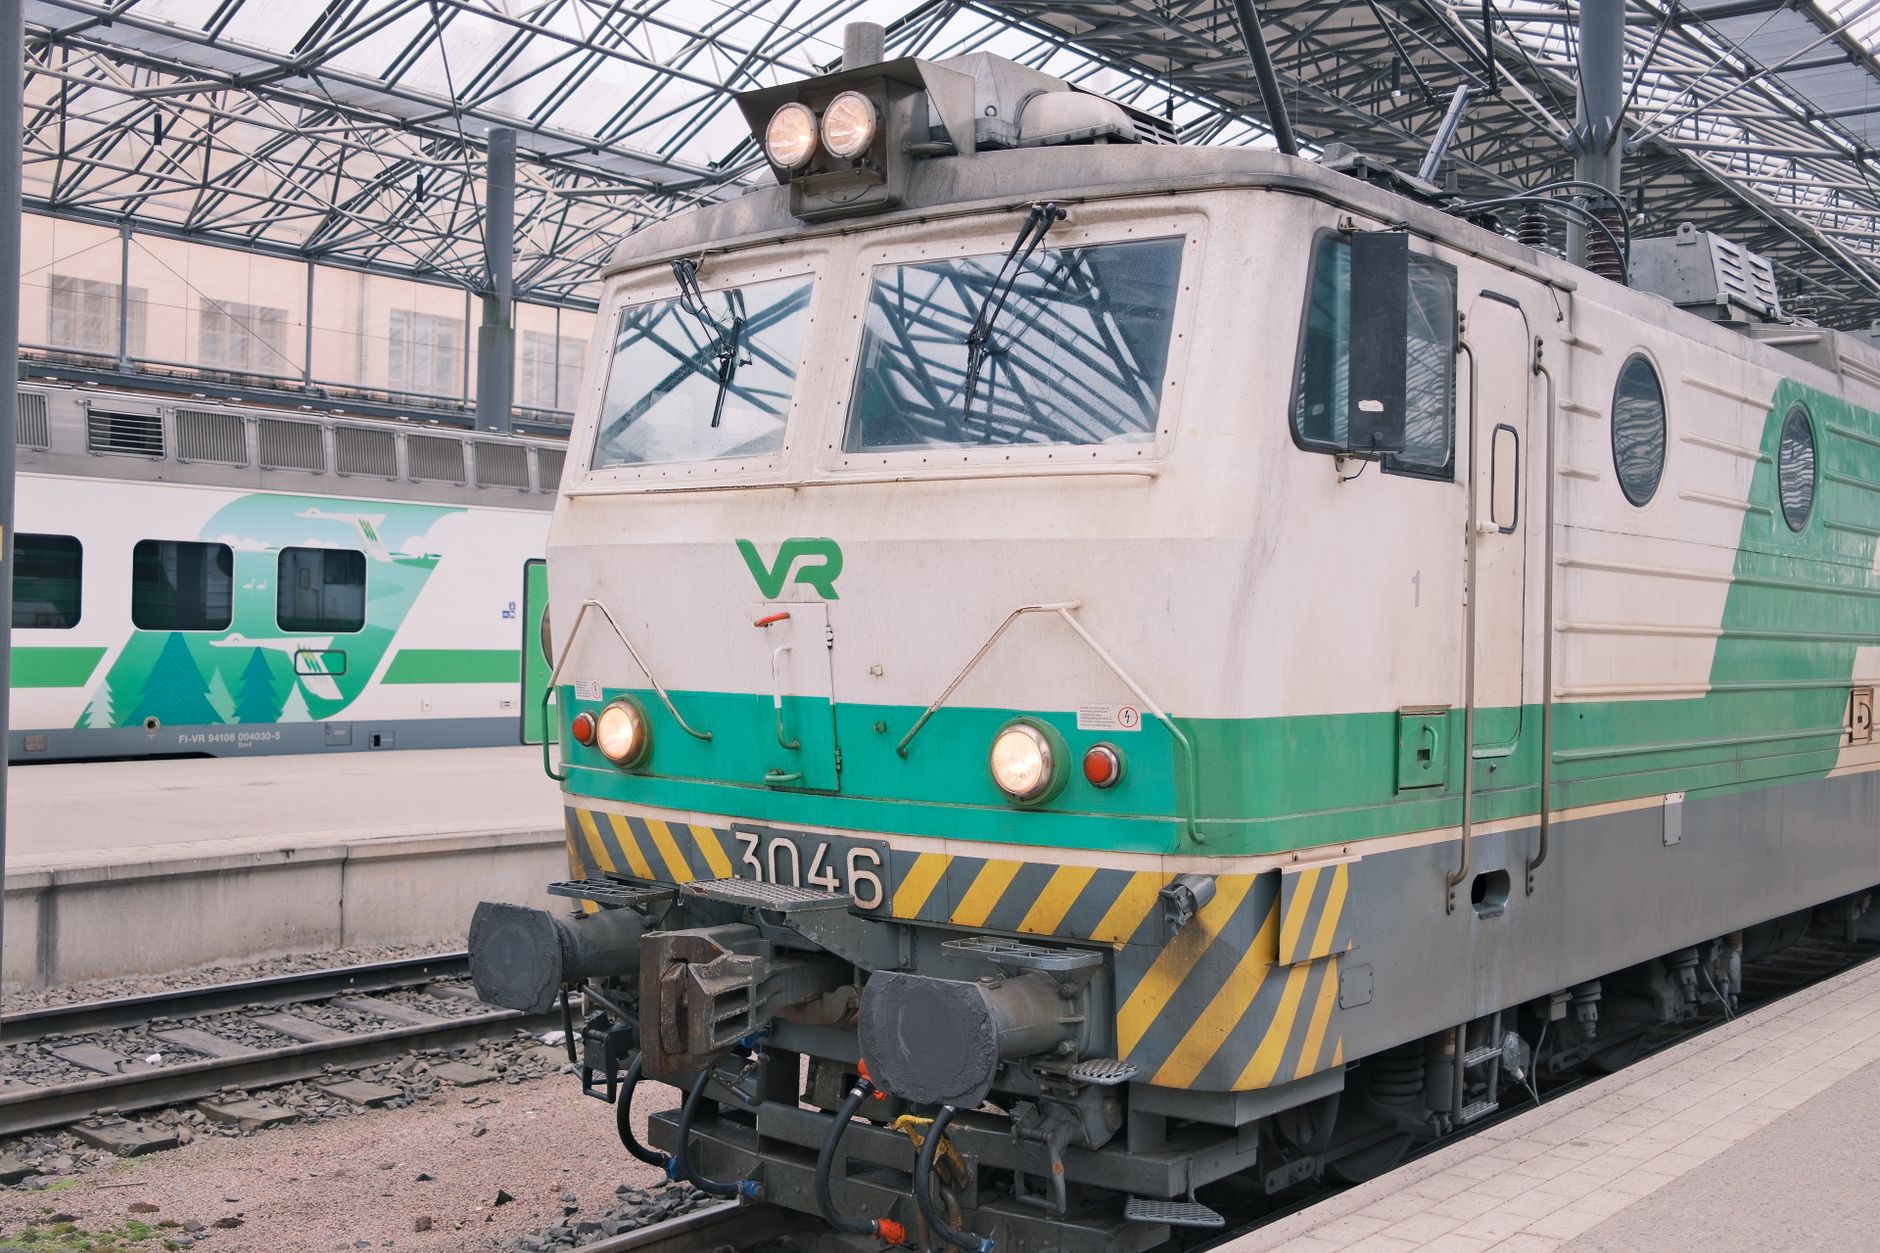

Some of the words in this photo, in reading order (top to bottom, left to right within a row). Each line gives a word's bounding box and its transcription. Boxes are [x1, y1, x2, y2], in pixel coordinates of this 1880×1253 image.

[735, 537, 843, 600] VR
[1411, 569, 1421, 608] 1
[178, 734, 206, 744] FI-VR
[208, 733, 236, 743] 94106
[238, 731, 281, 742] 004030-5
[735, 831, 883, 910] 3046
